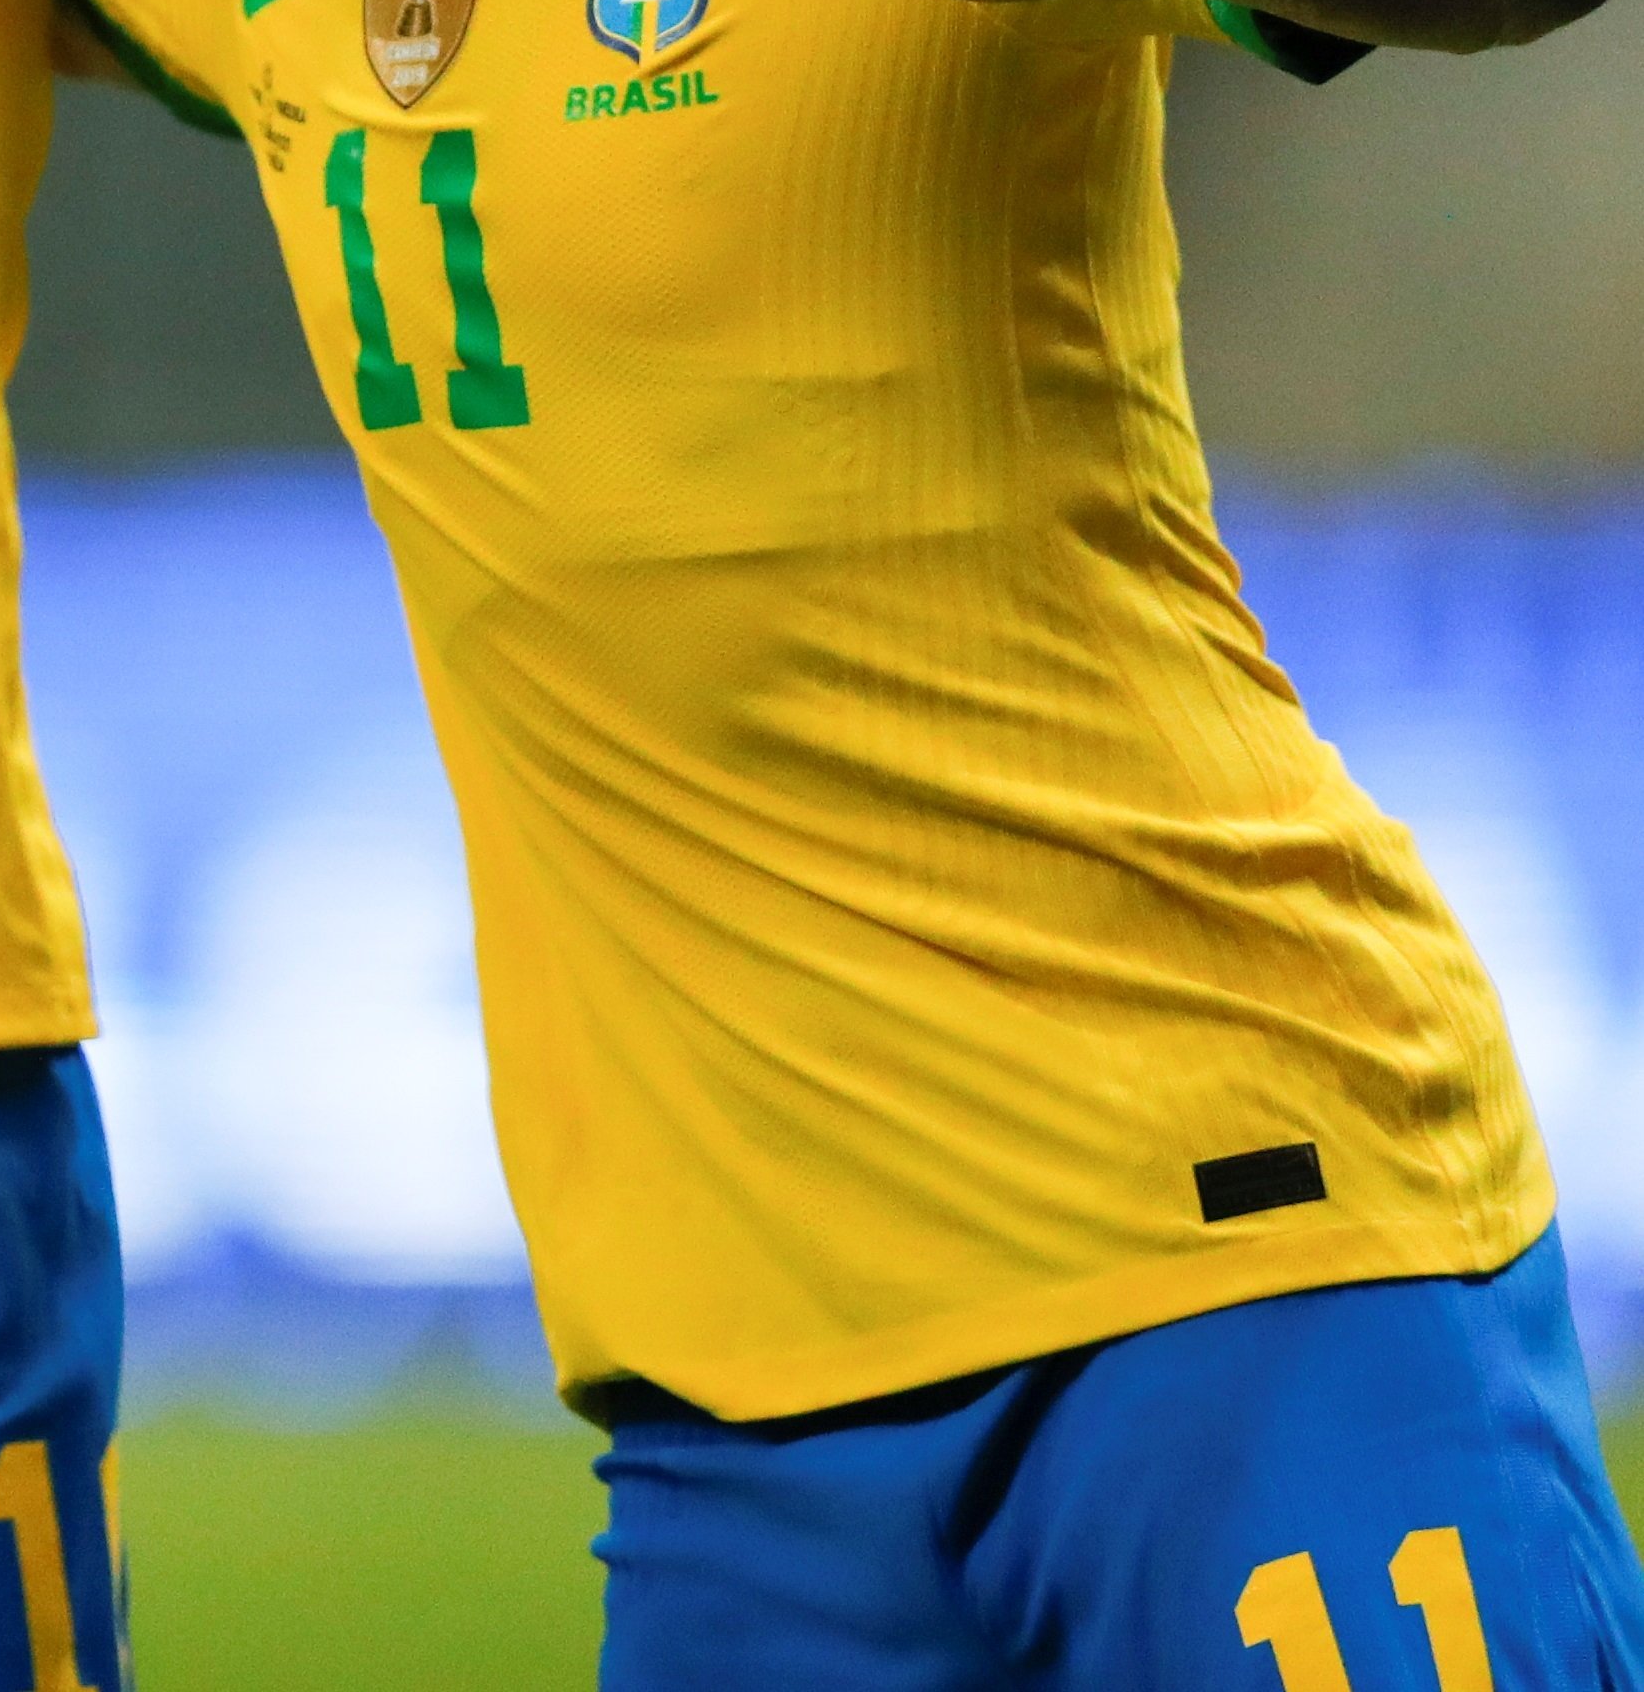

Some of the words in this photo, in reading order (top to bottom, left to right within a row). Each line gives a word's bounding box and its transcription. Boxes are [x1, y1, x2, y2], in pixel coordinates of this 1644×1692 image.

[565, 69, 720, 121] BRASIL
[324, 128, 530, 430] 11
[1234, 1525, 1495, 1692] 11
